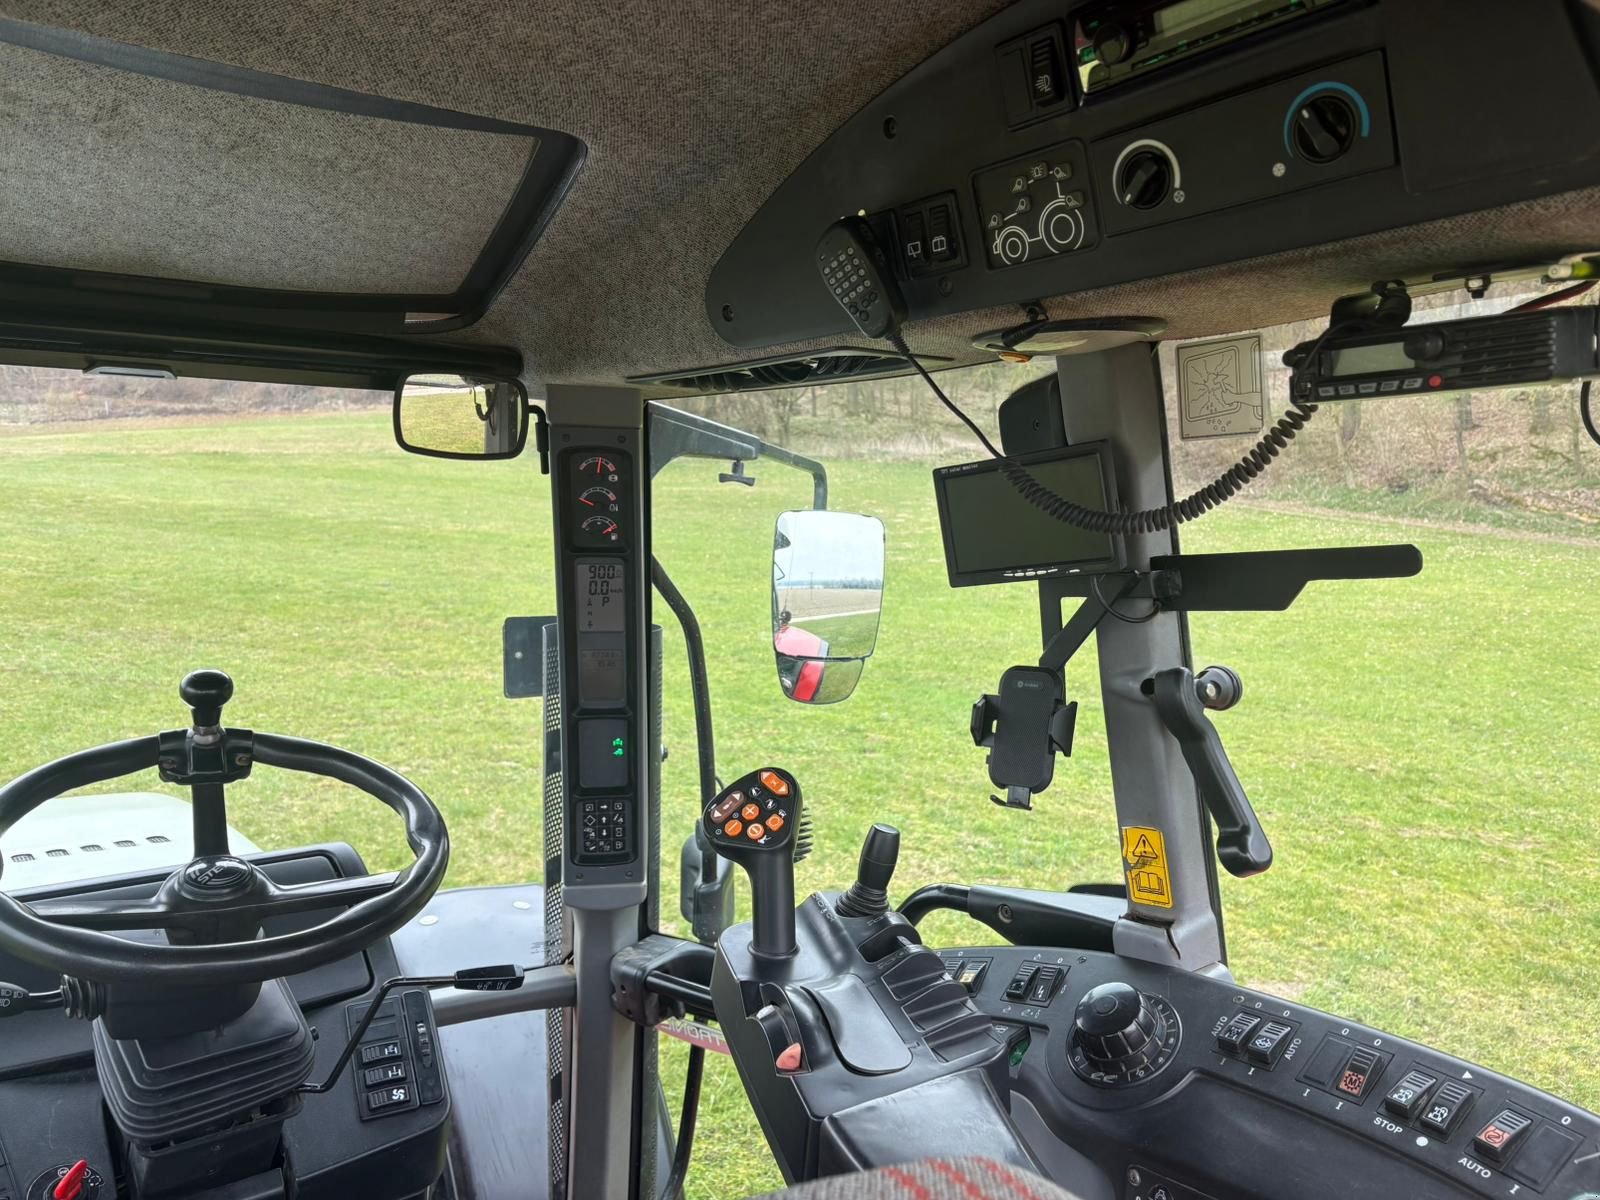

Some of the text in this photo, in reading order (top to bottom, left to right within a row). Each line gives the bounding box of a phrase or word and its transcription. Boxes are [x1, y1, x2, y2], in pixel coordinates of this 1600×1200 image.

[588, 565, 615, 579] 900
[588, 580, 609, 595] 0.0
[601, 596, 609, 607] P
[1211, 1016, 1228, 1037] AUTO
[1284, 1038, 1302, 1060] AUTO
[1373, 1116, 1403, 1134] STOP
[1458, 1157, 1492, 1178] AUTO
